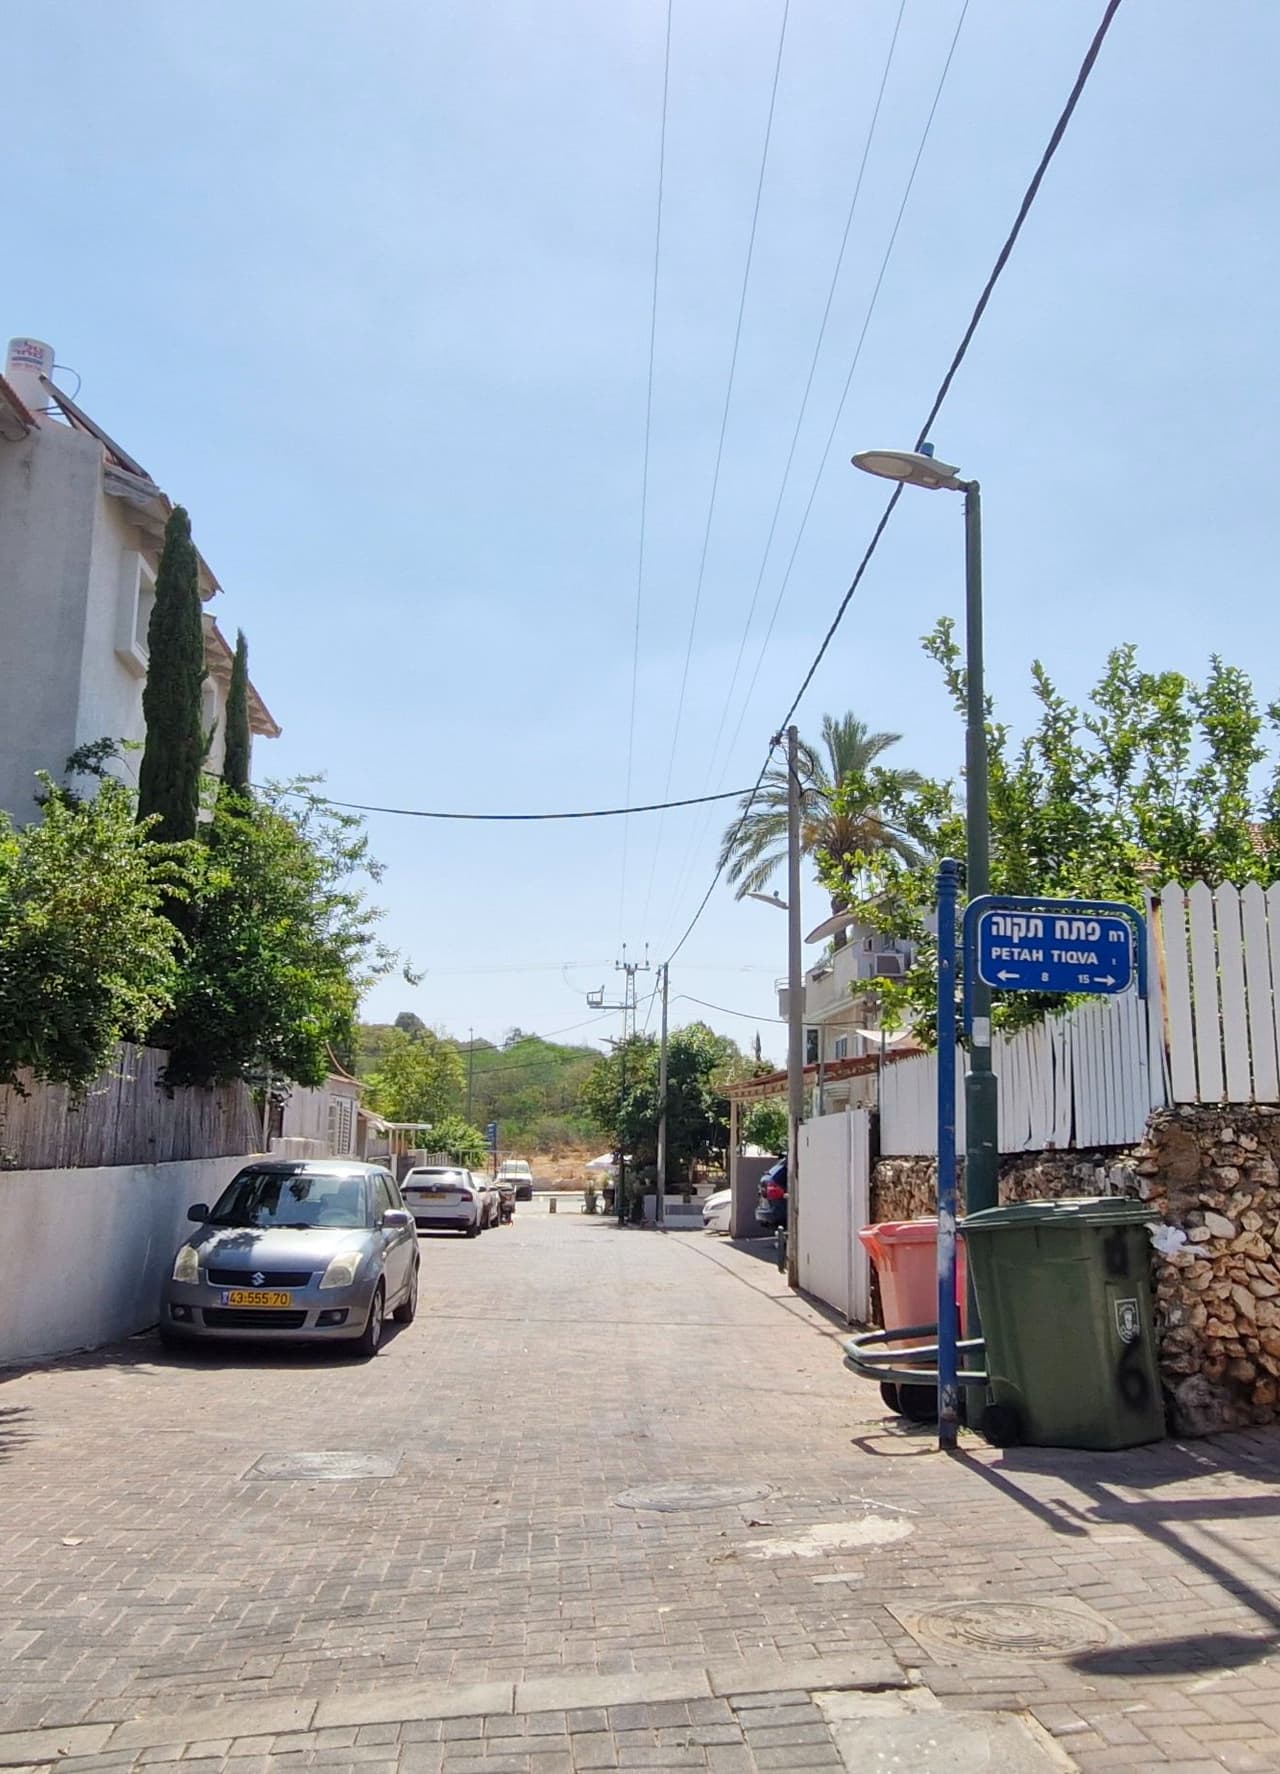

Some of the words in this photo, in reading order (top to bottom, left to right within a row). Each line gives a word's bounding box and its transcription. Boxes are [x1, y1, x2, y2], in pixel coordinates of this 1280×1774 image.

[991, 916, 1044, 944] תקוה
[1055, 920, 1102, 942] פתח
[991, 946, 1044, 962] PETAH
[1051, 950, 1099, 965] TIQVA
[1077, 974, 1090, 984] 15
